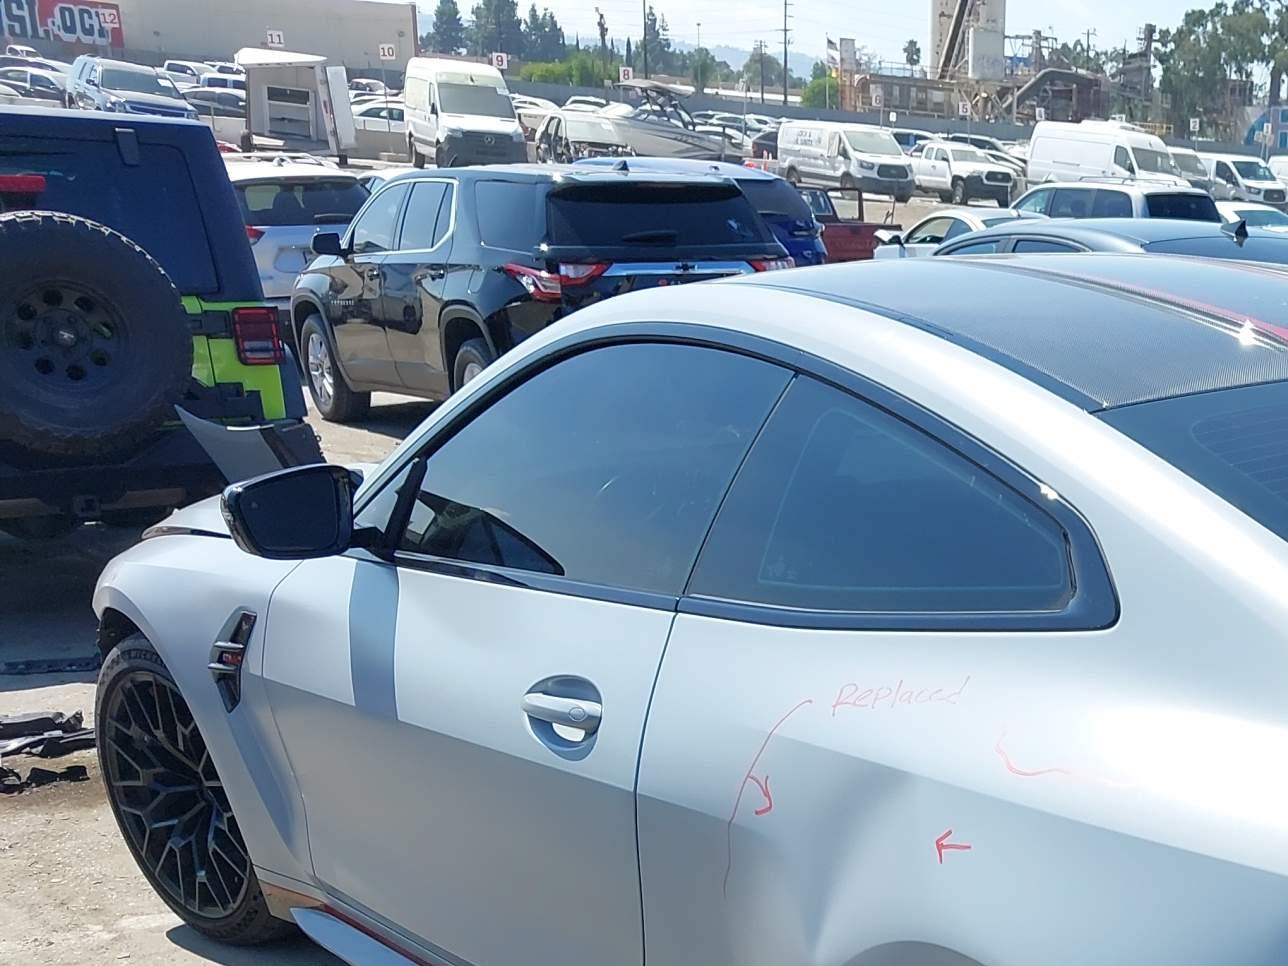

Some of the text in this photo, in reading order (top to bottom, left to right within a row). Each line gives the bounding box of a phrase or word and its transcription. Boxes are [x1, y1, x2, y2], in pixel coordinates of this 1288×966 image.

[101, 13, 117, 24] 12
[268, 34, 283, 45] 11
[380, 46, 394, 58] 10
[496, 54, 504, 67] 9
[623, 69, 630, 80] 8
